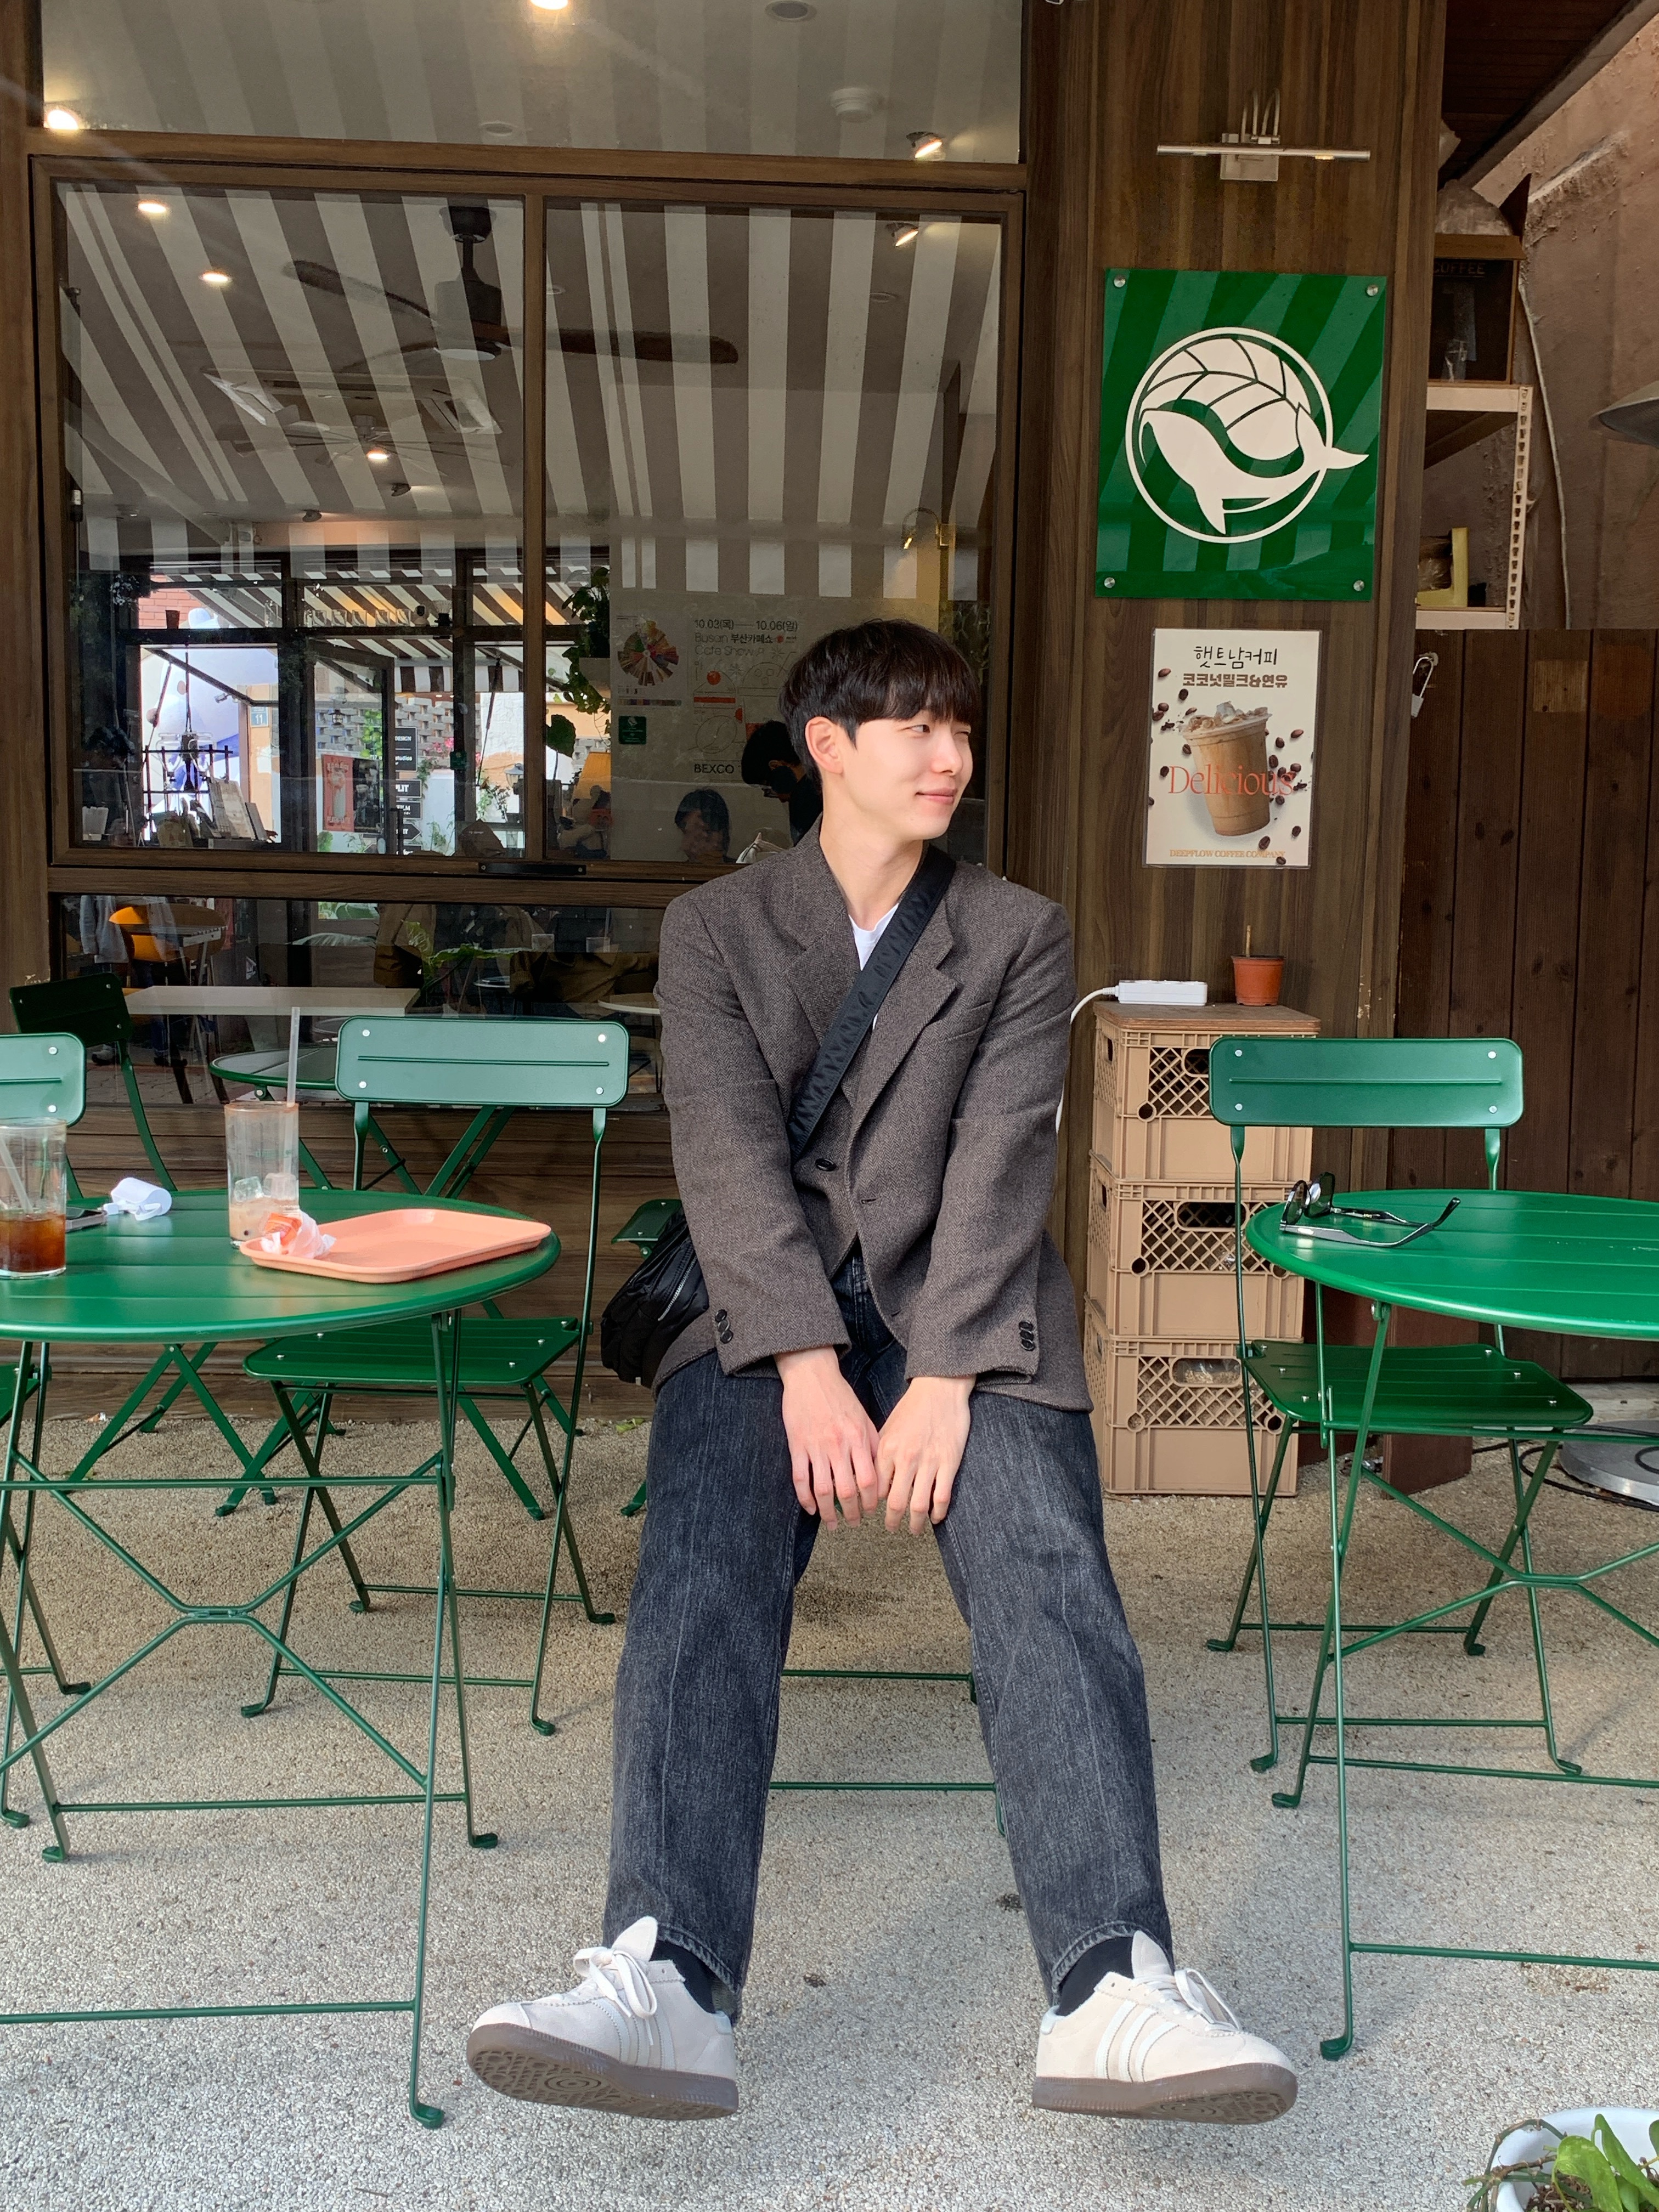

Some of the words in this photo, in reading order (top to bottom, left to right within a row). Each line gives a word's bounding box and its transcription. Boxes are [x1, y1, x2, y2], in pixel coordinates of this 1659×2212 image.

[756, 620, 798, 631] 10.06(일)
[695, 632, 729, 643] Busan
[731, 633, 773, 643] 부산카페쇼
[695, 645, 721, 655] Cafe
[1194, 646, 1277, 669] 햇트남커피
[1183, 673, 1288, 688] 코코넛밀크&연유
[694, 763, 735, 774] BEXCO
[1168, 763, 1295, 795] Delicious
